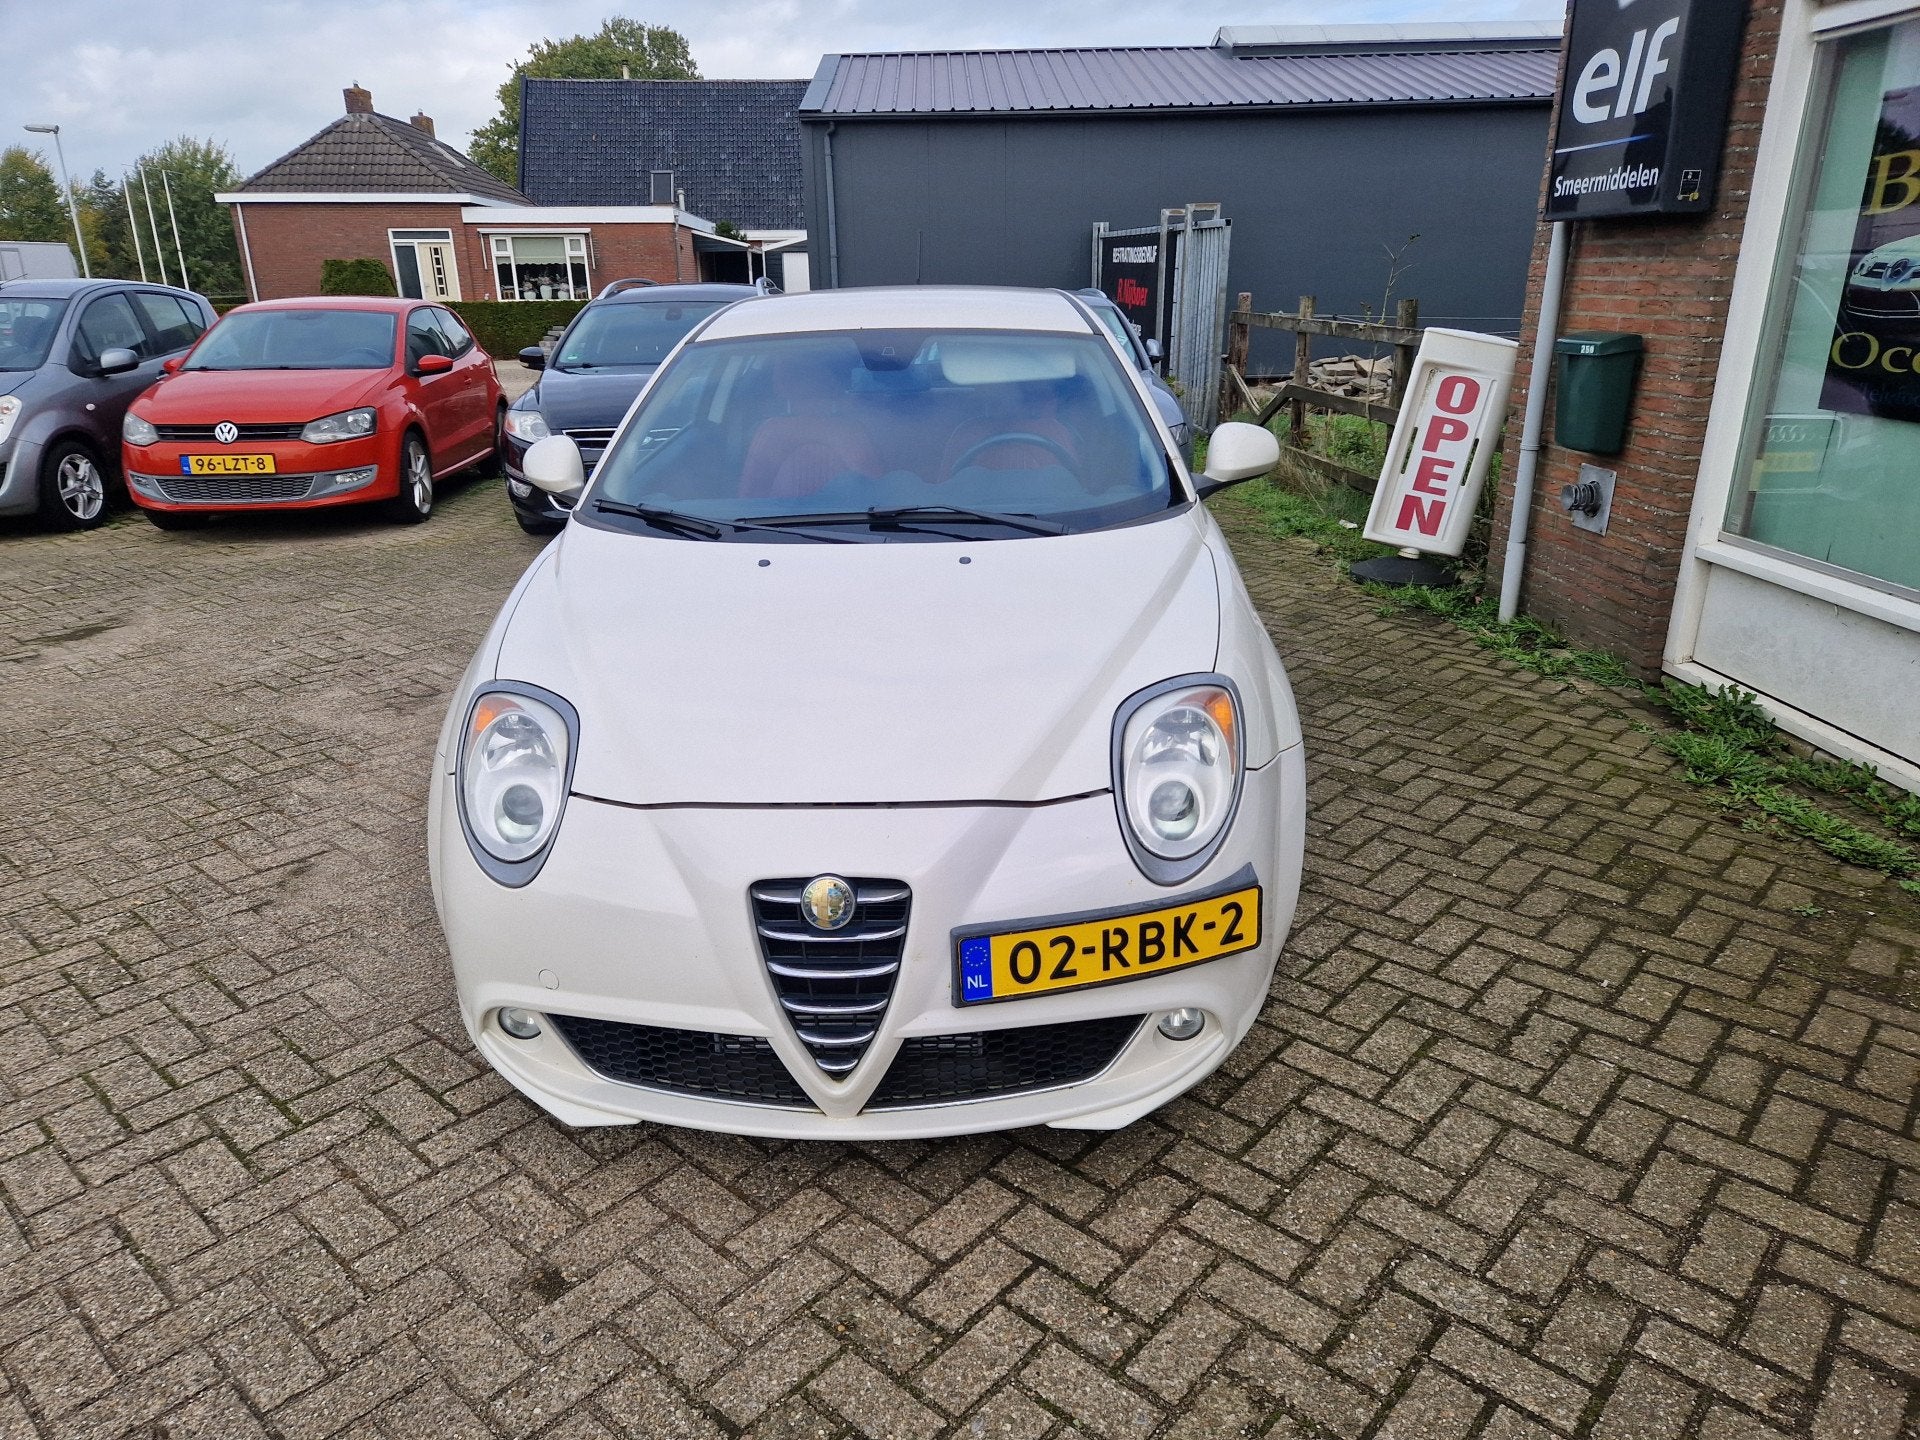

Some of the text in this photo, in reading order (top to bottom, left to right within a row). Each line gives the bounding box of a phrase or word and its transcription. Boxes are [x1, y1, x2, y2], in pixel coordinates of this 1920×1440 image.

[1572, 16, 1680, 124] elf
[1553, 162, 1660, 198] Smeermiddelen
[195, 457, 266, 472] 96-LZT-8
[1395, 375, 1481, 537] OPEN
[967, 900, 1245, 990] NL 02-RBK-2
